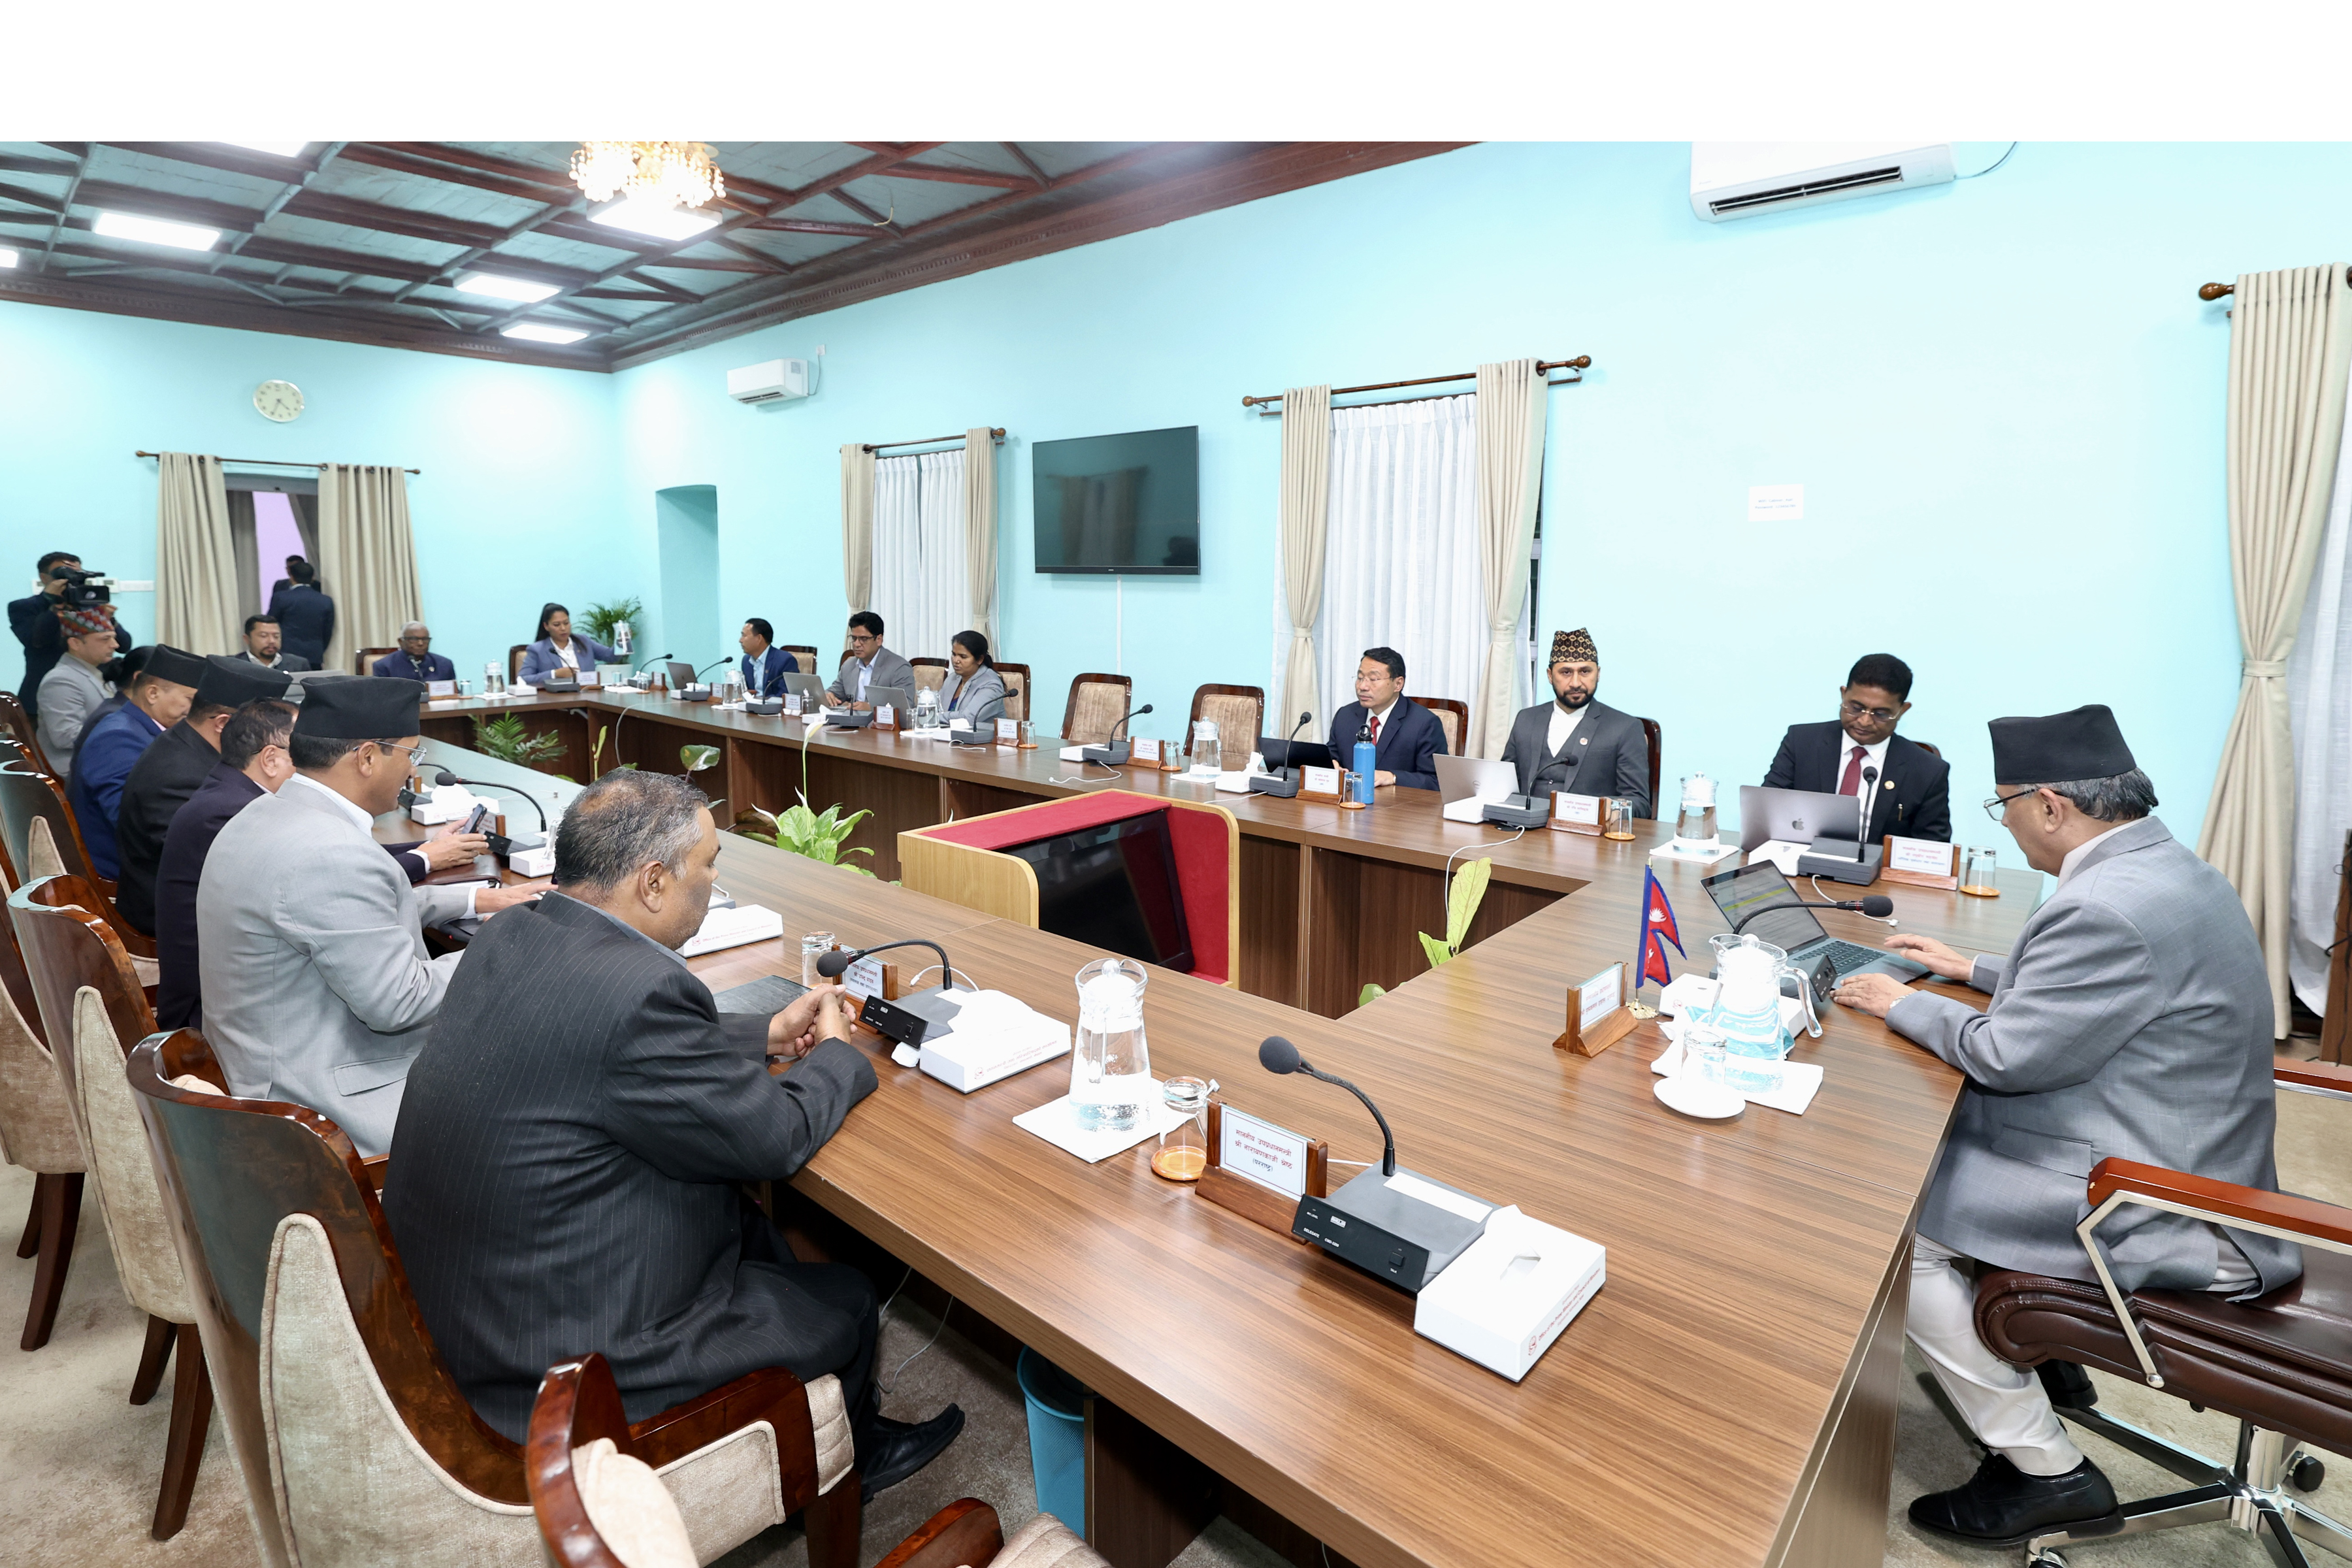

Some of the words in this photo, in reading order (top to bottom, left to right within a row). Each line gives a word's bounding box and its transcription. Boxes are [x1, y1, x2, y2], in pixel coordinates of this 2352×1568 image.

[1235, 1129, 1255, 1141] माननीय
[1258, 1138, 1292, 1157] उपप्रधानमन्त्री
[1244, 1143, 1279, 1163] नारायणकाजी
[1281, 1158, 1293, 1169] श्रेष्ठ
[1252, 1158, 1273, 1172] (परराष्ट्र)
[1303, 1227, 1320, 1239] DELEGATE
